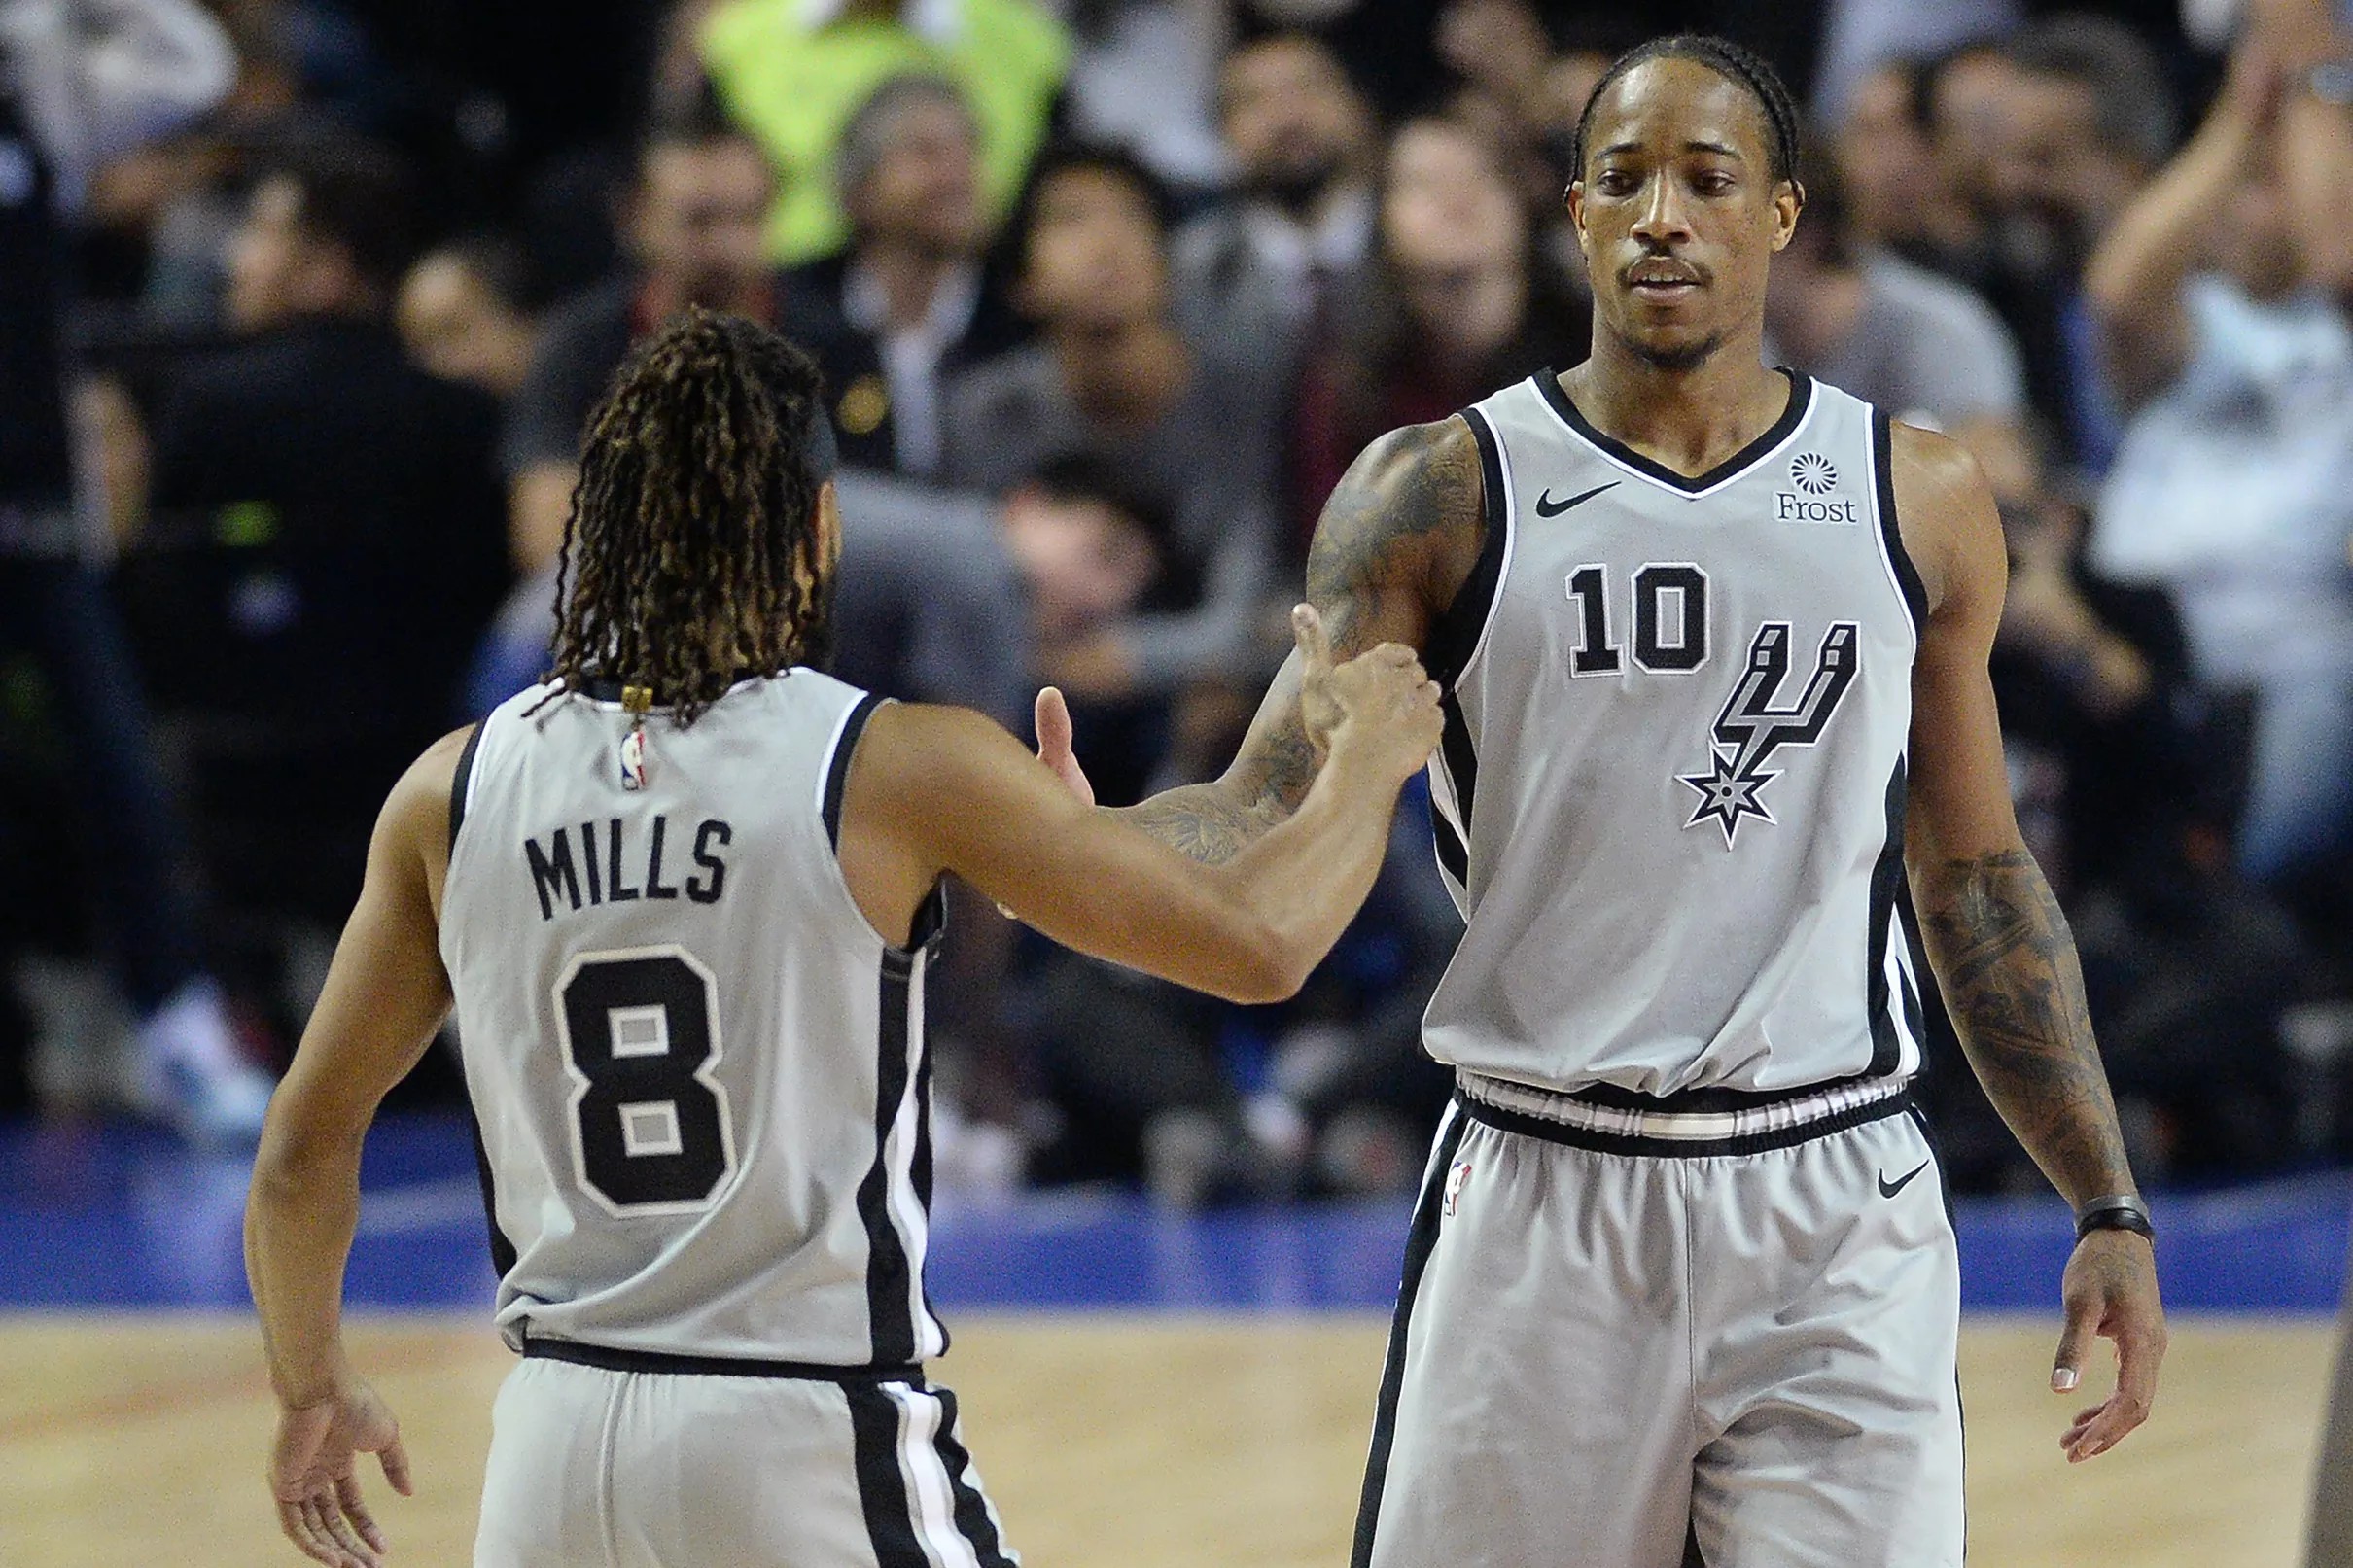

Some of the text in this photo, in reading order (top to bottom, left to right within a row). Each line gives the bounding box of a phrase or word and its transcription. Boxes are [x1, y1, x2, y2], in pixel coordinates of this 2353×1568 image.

[1777, 494, 1857, 523] Frost
[1566, 563, 1710, 678] 10
[525, 815, 732, 922] MILLS
[552, 944, 738, 1219] 8
